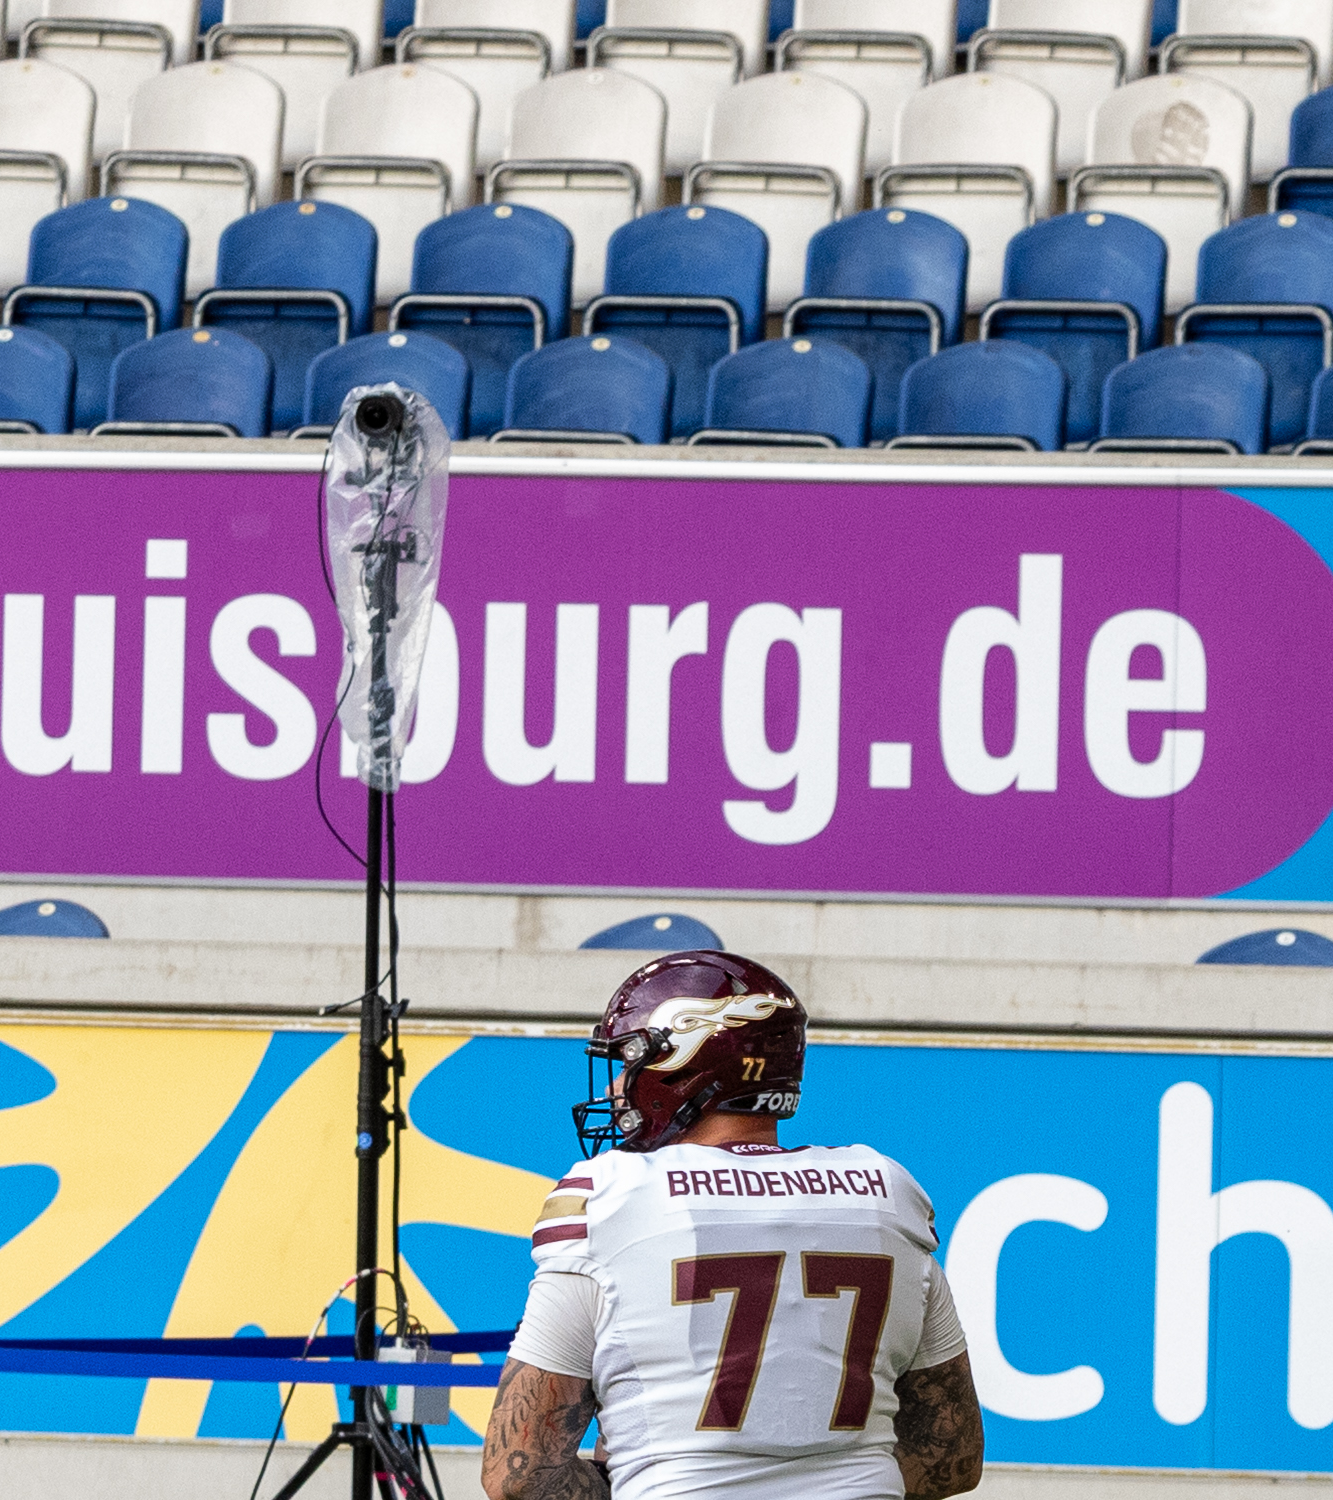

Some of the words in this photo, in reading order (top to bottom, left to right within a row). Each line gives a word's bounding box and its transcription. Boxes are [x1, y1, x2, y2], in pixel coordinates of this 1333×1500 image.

[741, 1057, 766, 1081] 77
[667, 1168, 888, 1199] BREIDENBACH
[671, 1250, 895, 1434] 77
